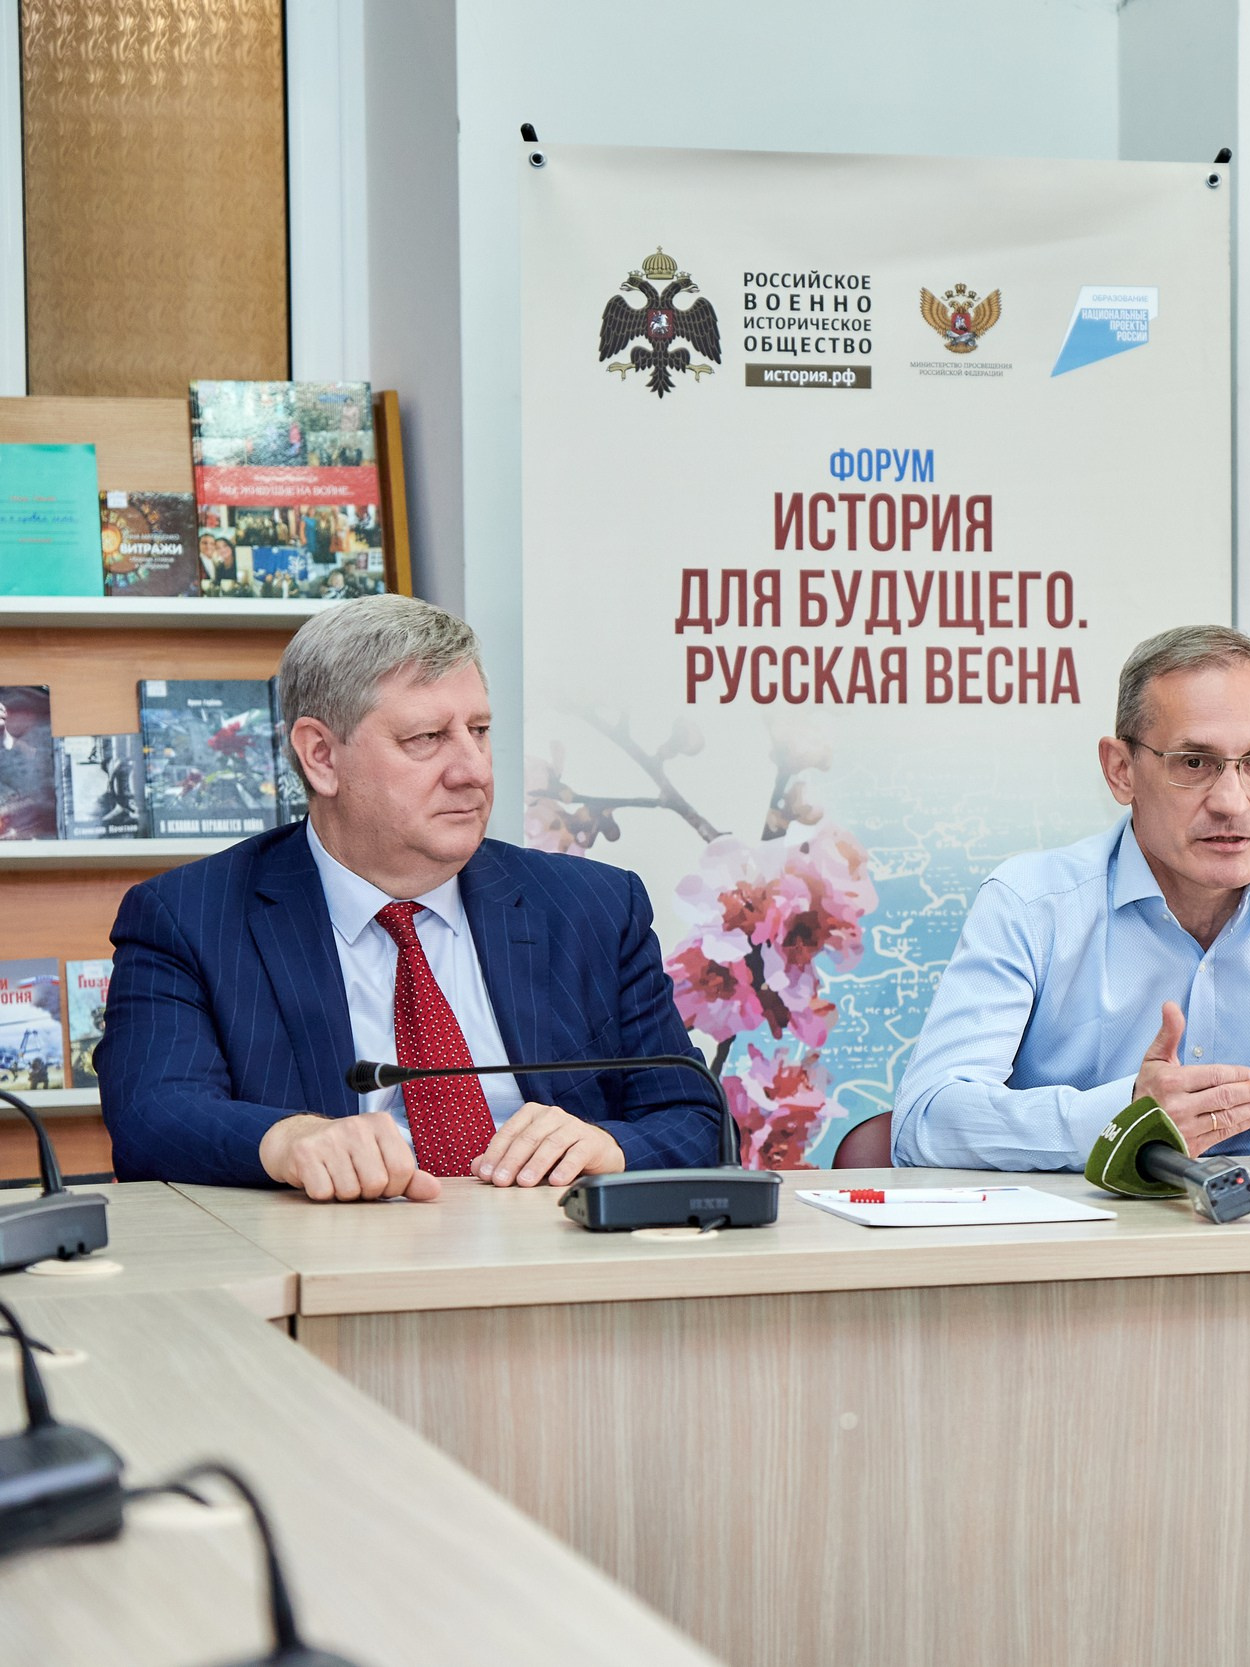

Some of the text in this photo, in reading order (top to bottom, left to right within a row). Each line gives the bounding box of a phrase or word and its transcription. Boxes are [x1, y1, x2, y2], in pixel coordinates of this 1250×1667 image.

[744, 270, 871, 290] РОССИЙСКОЕ
[744, 292, 872, 313] ВОЕННО
[1092, 294, 1148, 303] ОБРАЗОВАНИЕ
[744, 316, 872, 332] ИСТОРИЧЕСКОЕ
[1081, 309, 1148, 321] НАЦИОНАЛЬНЫЕ
[1110, 321, 1148, 331] ПРОЕКТЫ
[744, 335, 872, 356] ОБЩЕСТВО
[1116, 331, 1148, 342] РОССИИ
[764, 367, 856, 386] история.рф
[829, 447, 935, 482] ФОРУМ
[774, 492, 993, 552] ИСТОРИЯ
[120, 543, 183, 555] ВИТРАЖИ
[675, 568, 1088, 635] ДЛЯ БУДУЩЕГО.
[686, 645, 1081, 704] РУССКАЯ ВЕСНА
